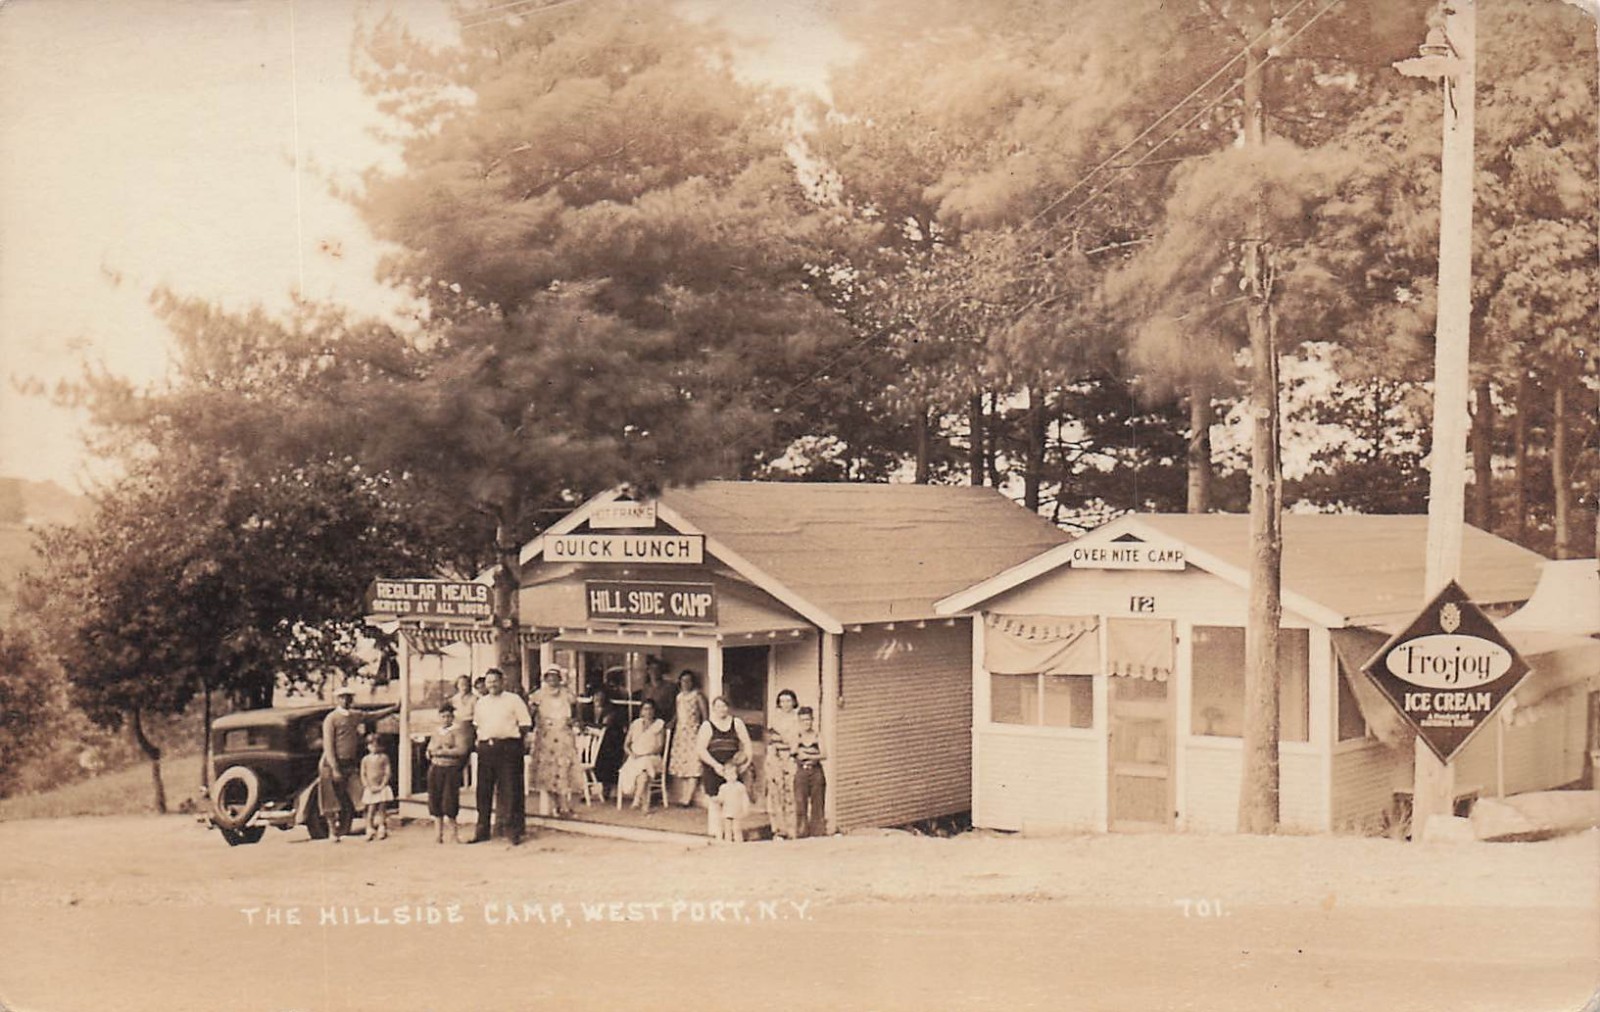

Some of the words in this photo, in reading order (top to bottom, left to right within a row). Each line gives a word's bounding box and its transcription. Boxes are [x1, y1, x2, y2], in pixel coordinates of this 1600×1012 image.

[554, 540, 613, 556] QUICK
[623, 540, 690, 557] LUNCH
[1073, 548, 1107, 561] OVER
[1112, 549, 1140, 562] NITE
[1147, 550, 1184, 563] CAMP
[376, 582, 436, 600] REGULAR
[441, 583, 488, 602] MEALS
[416, 601, 430, 613] AT
[436, 602, 455, 614] ALL
[670, 592, 712, 617] CAMP
[1130, 596, 1155, 613] 12
[1404, 692, 1432, 712] ICE
[1433, 692, 1492, 712] CREAM
